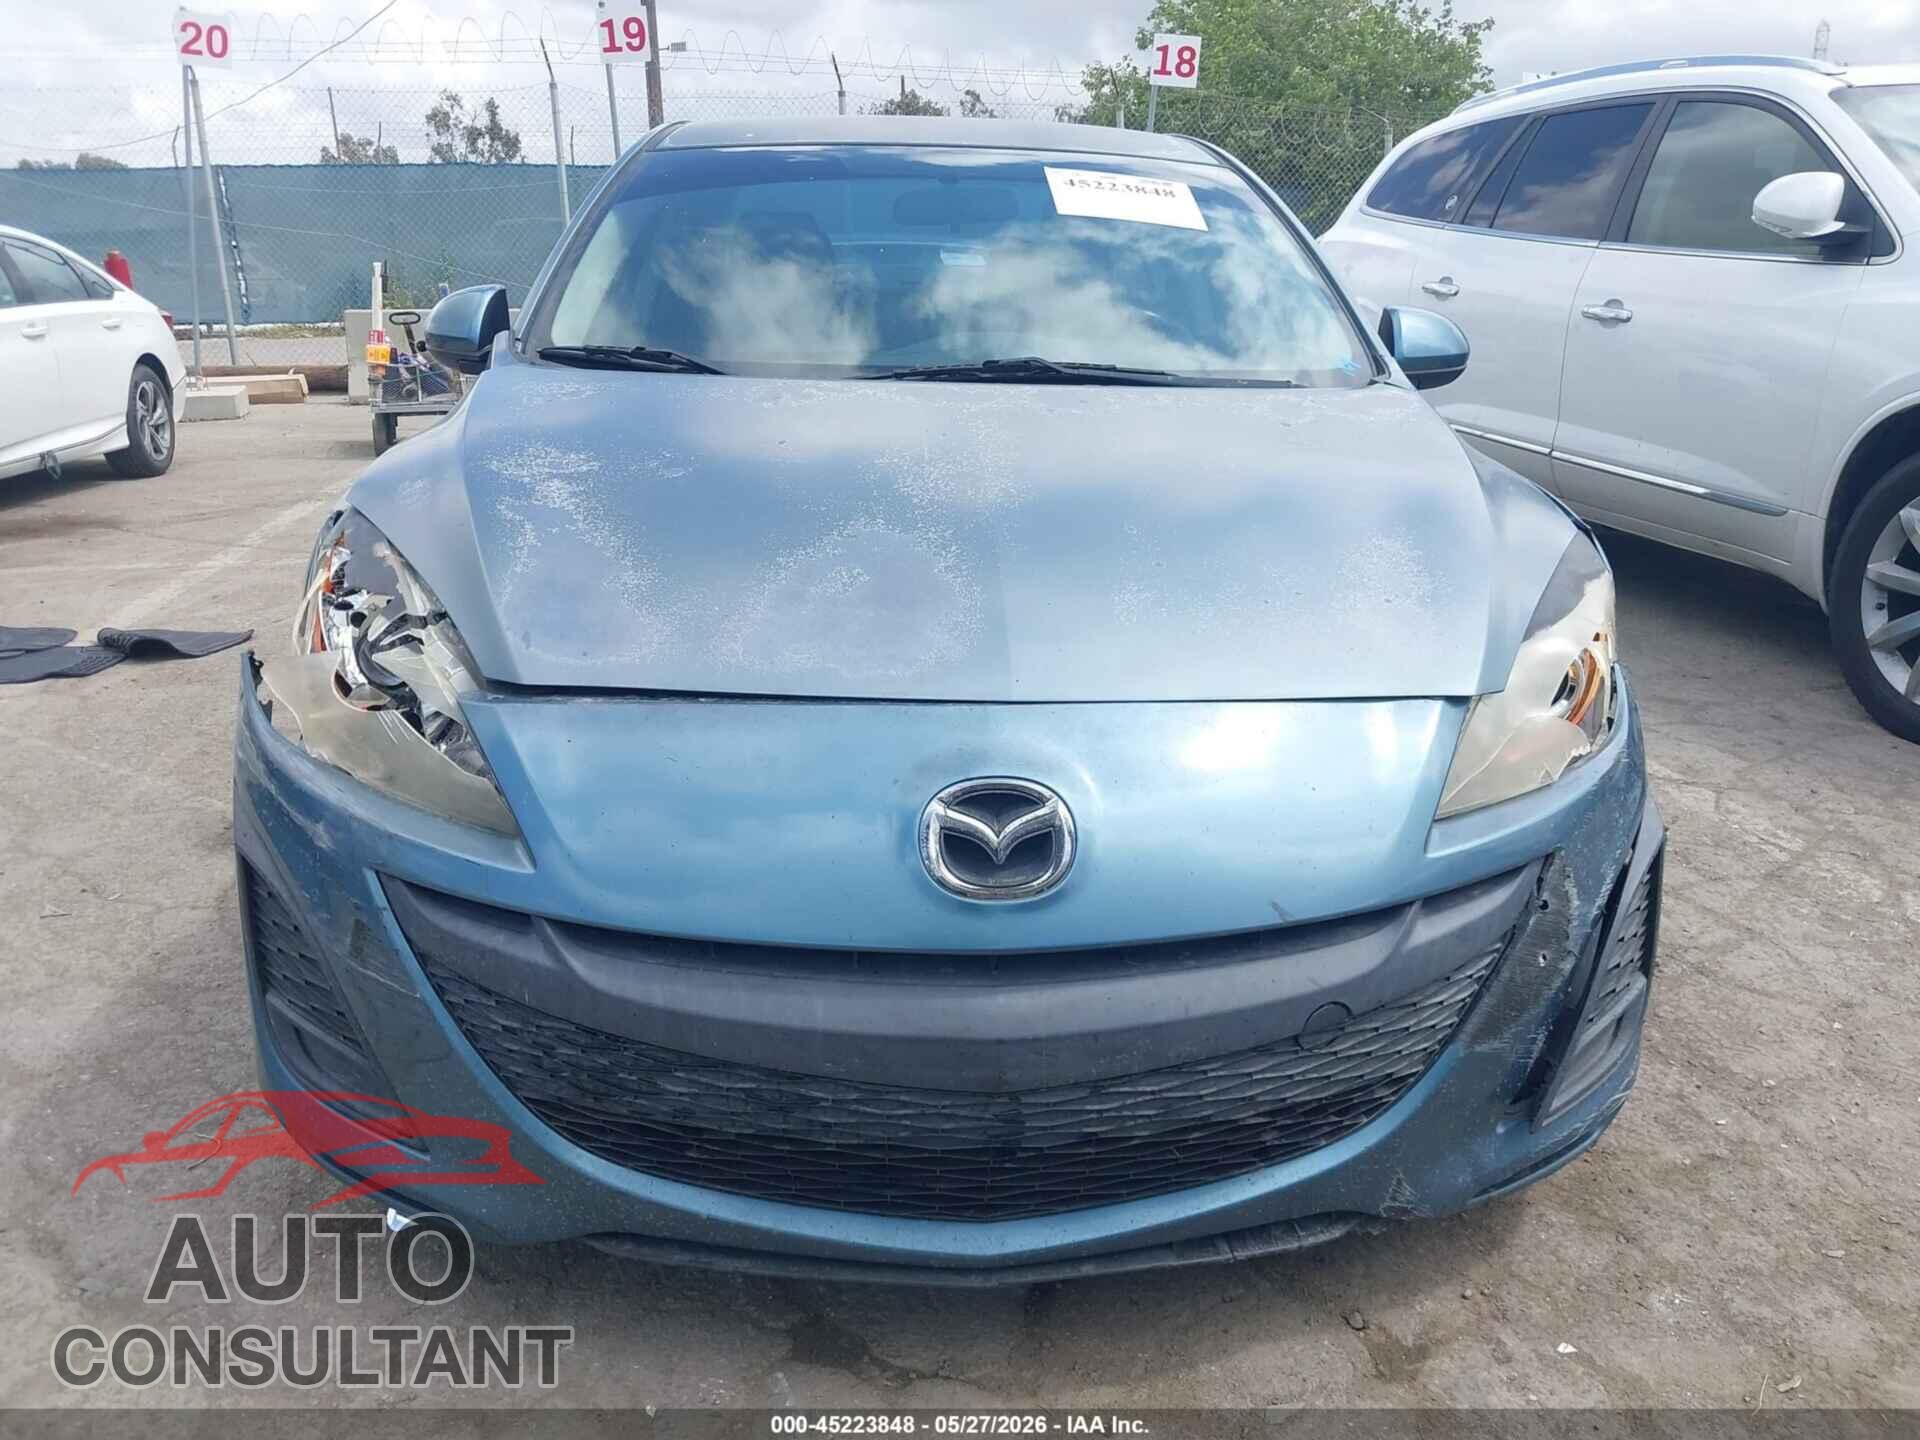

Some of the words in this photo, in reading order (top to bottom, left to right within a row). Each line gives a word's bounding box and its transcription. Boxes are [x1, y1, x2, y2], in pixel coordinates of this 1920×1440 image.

[180, 21, 228, 58] 20
[599, 16, 646, 53] 19
[1153, 44, 1197, 78] 18
